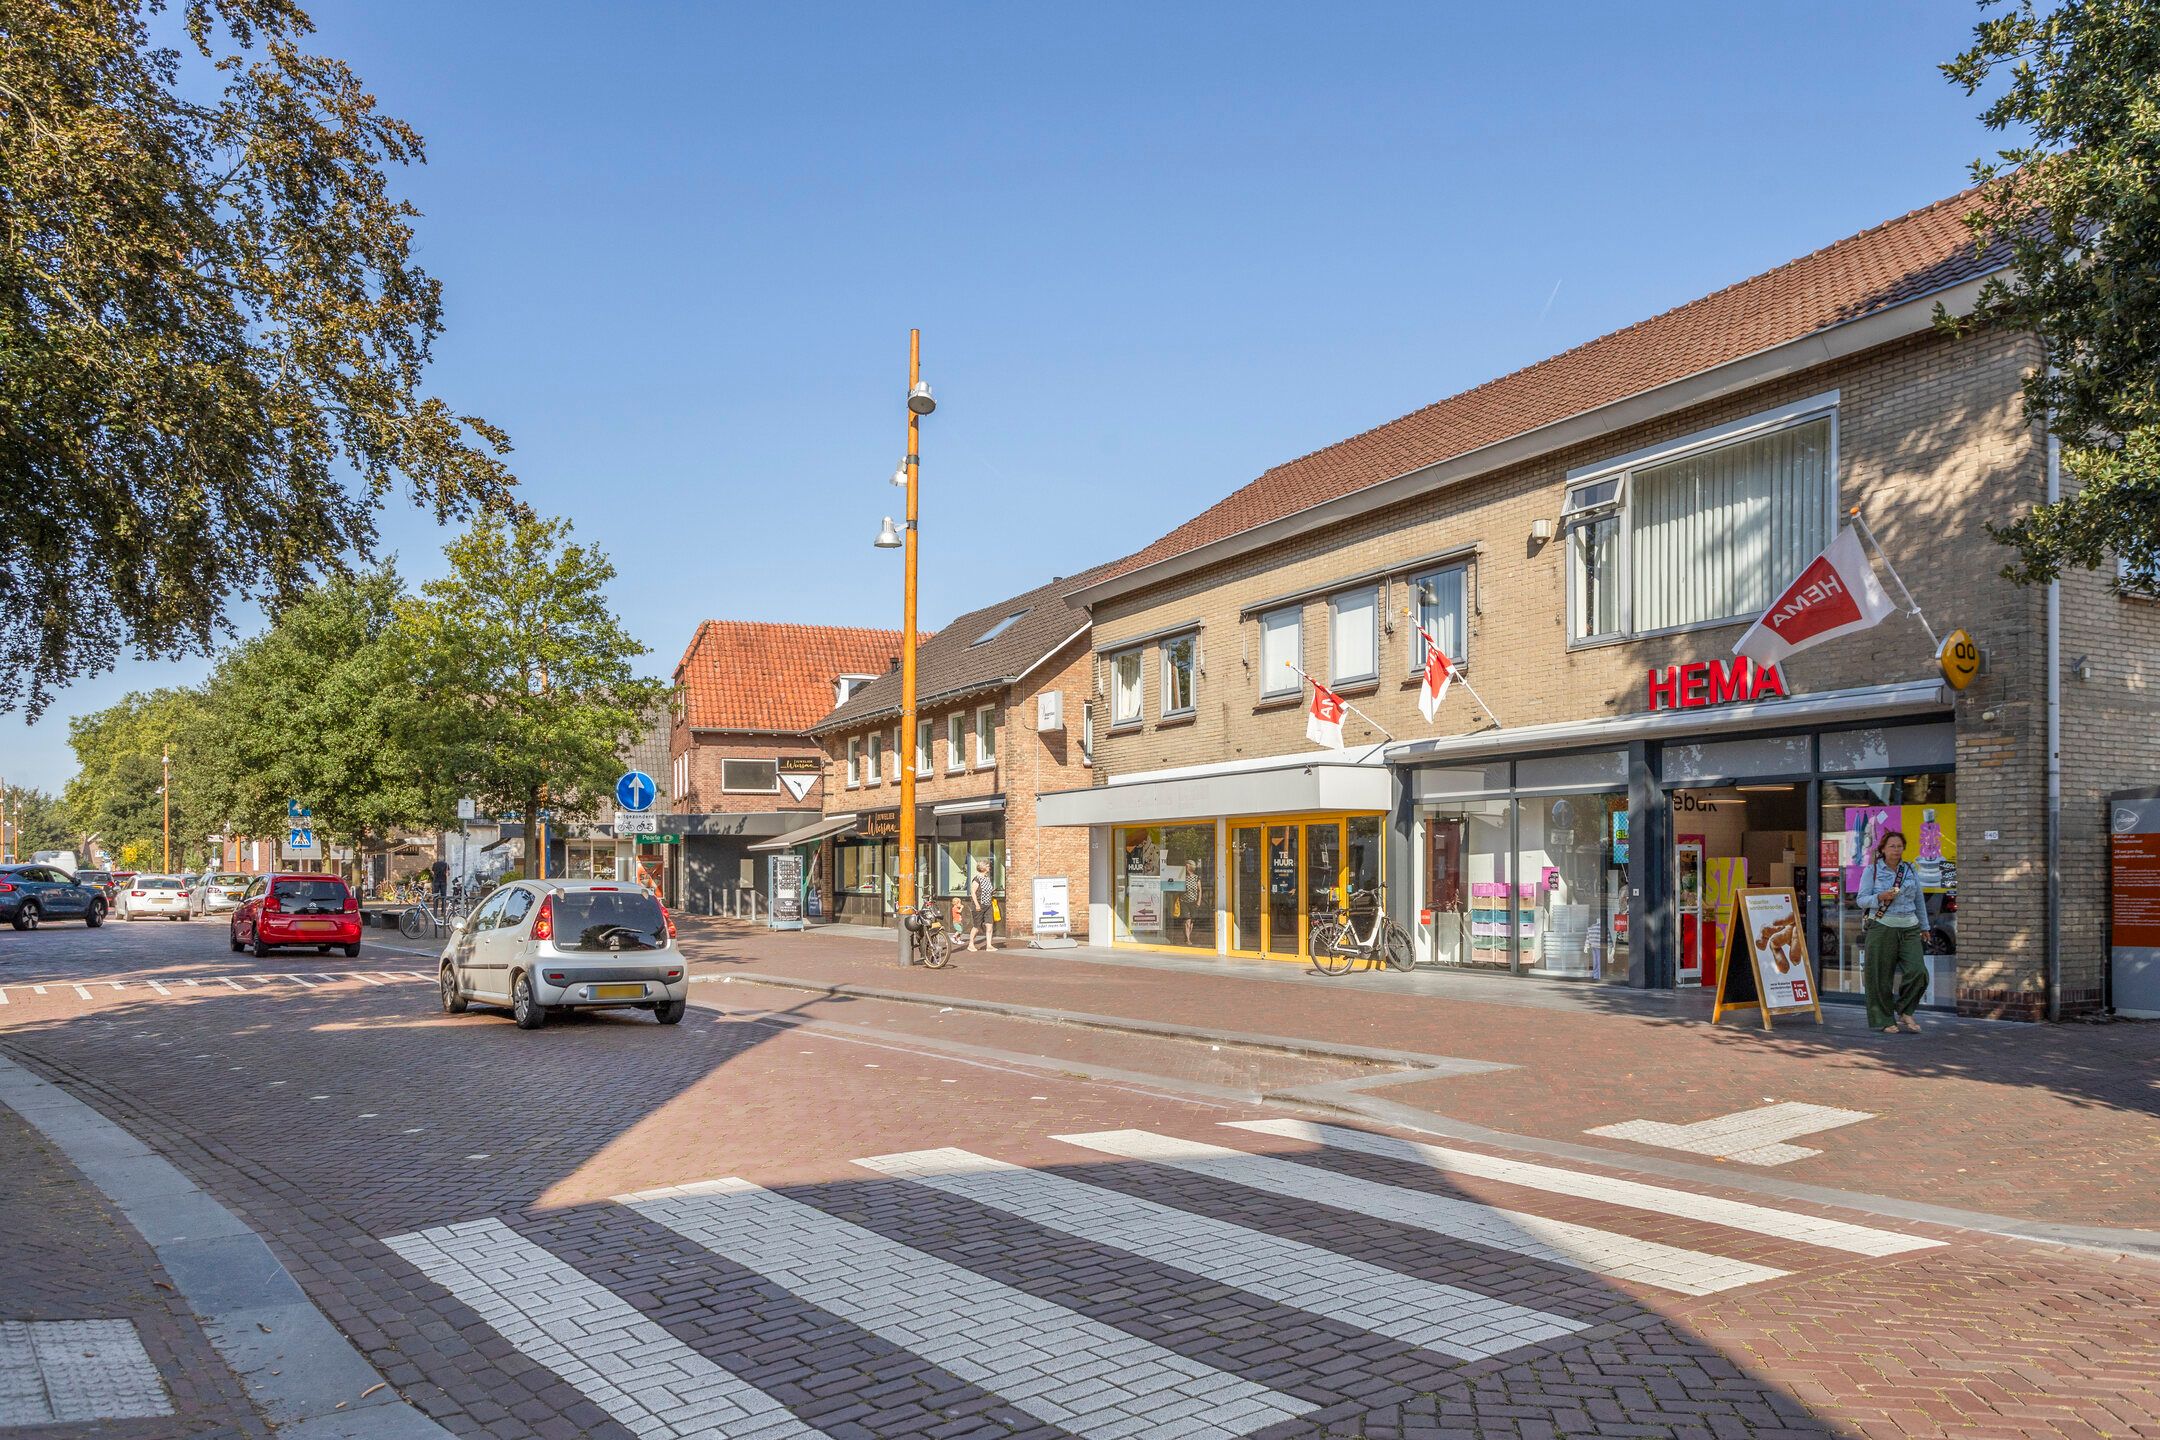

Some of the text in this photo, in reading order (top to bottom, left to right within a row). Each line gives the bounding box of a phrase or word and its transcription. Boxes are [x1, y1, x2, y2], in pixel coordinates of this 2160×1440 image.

[1648, 656, 1788, 711] HEMA
[1279, 851, 1288, 859] TE
[1274, 859, 1294, 867] HUUR
